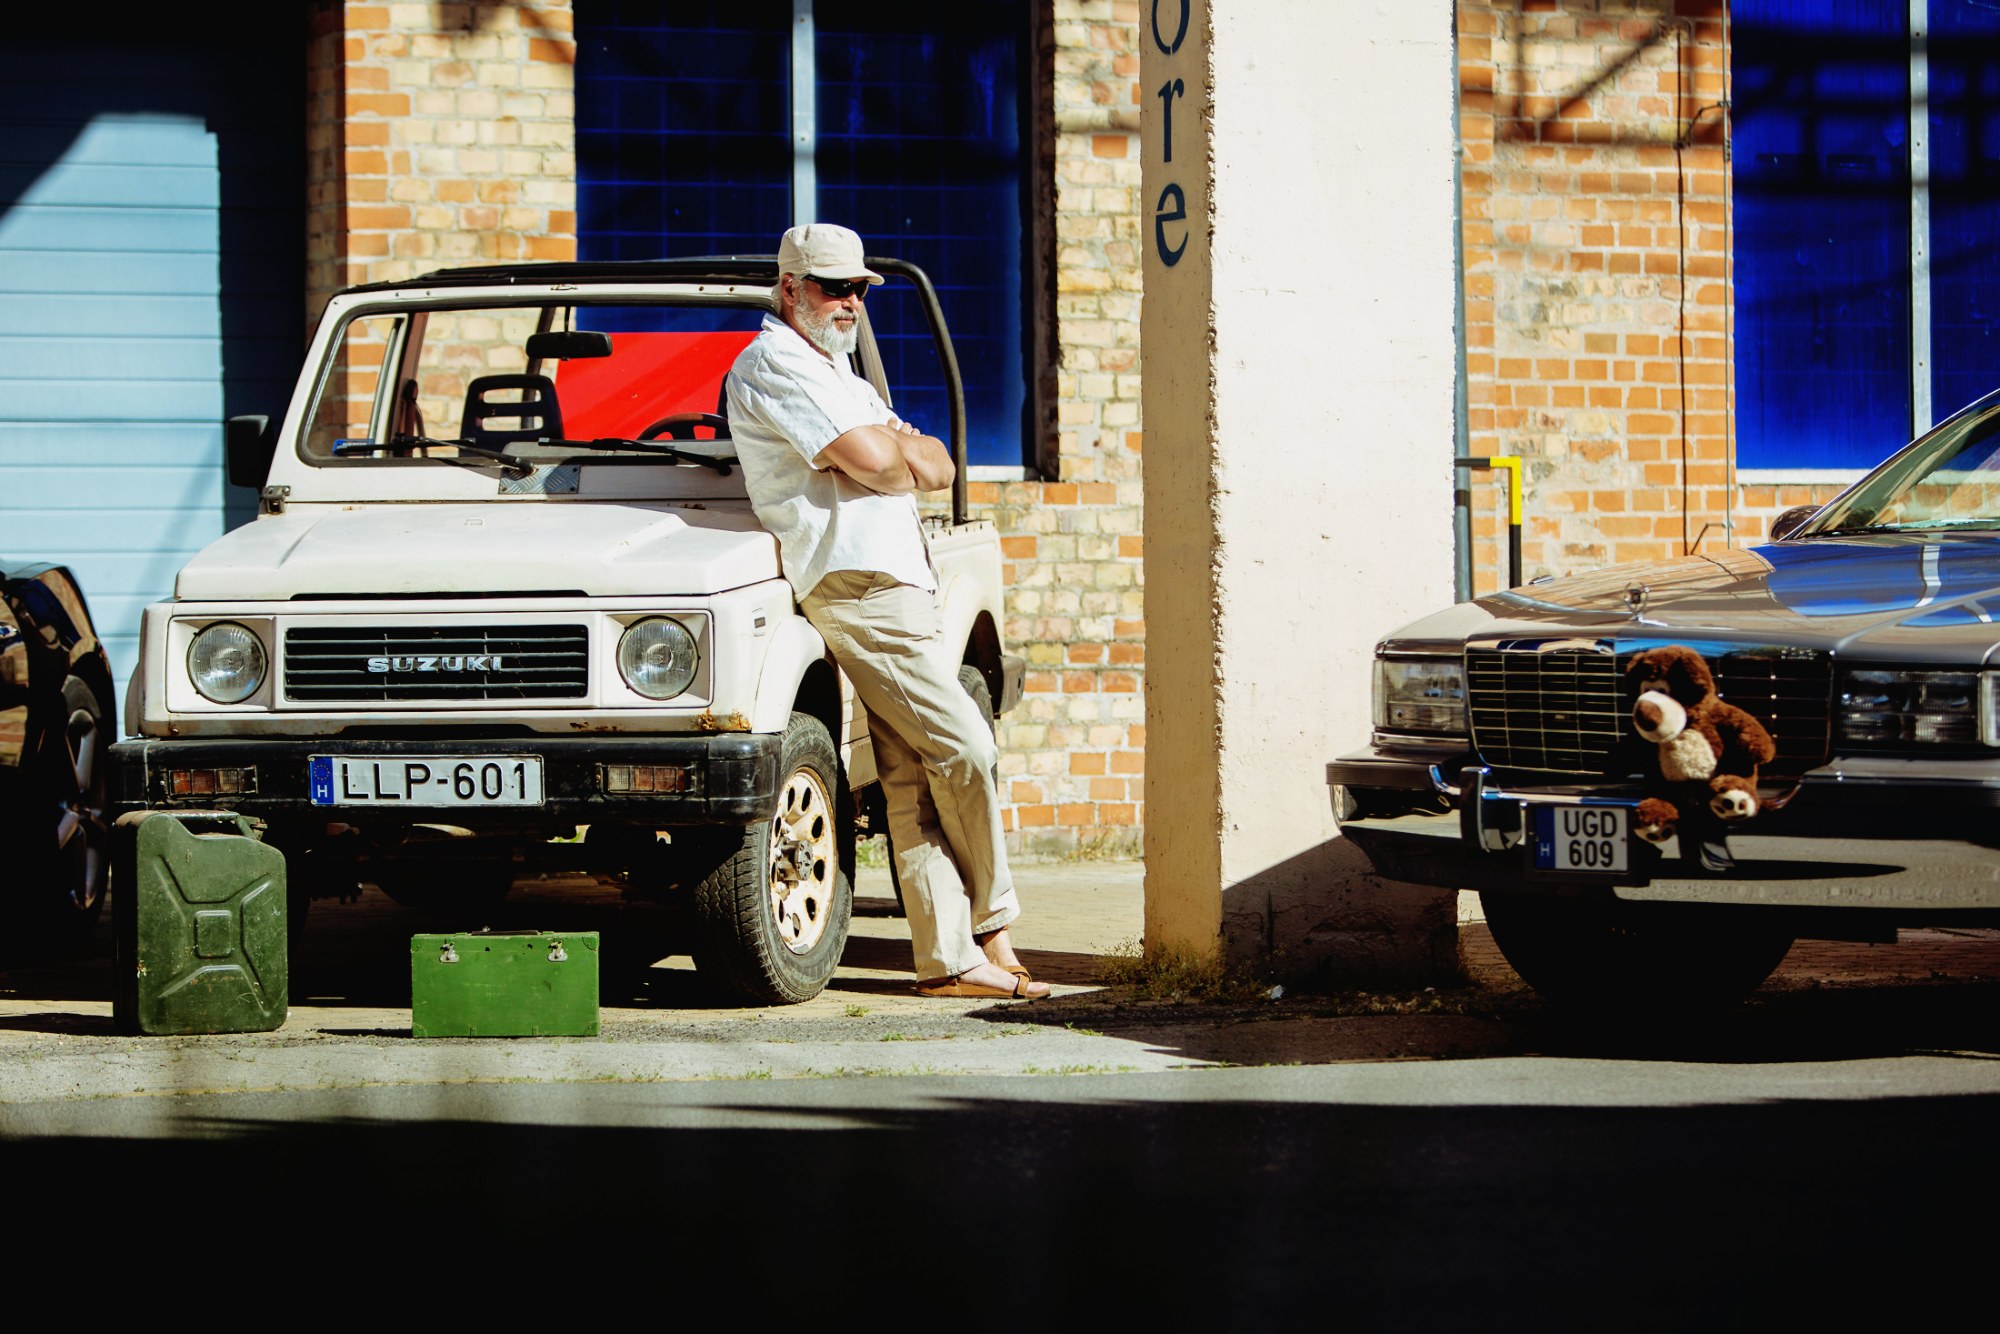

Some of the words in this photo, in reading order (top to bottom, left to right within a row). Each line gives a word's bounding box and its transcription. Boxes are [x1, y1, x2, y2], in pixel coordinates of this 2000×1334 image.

[367, 656, 502, 673] SUZUKI
[317, 784, 328, 798] H
[342, 762, 526, 800] LLP-601
[1564, 810, 1617, 838] UGD
[1541, 843, 1550, 856] H
[1569, 840, 1613, 867] 609
